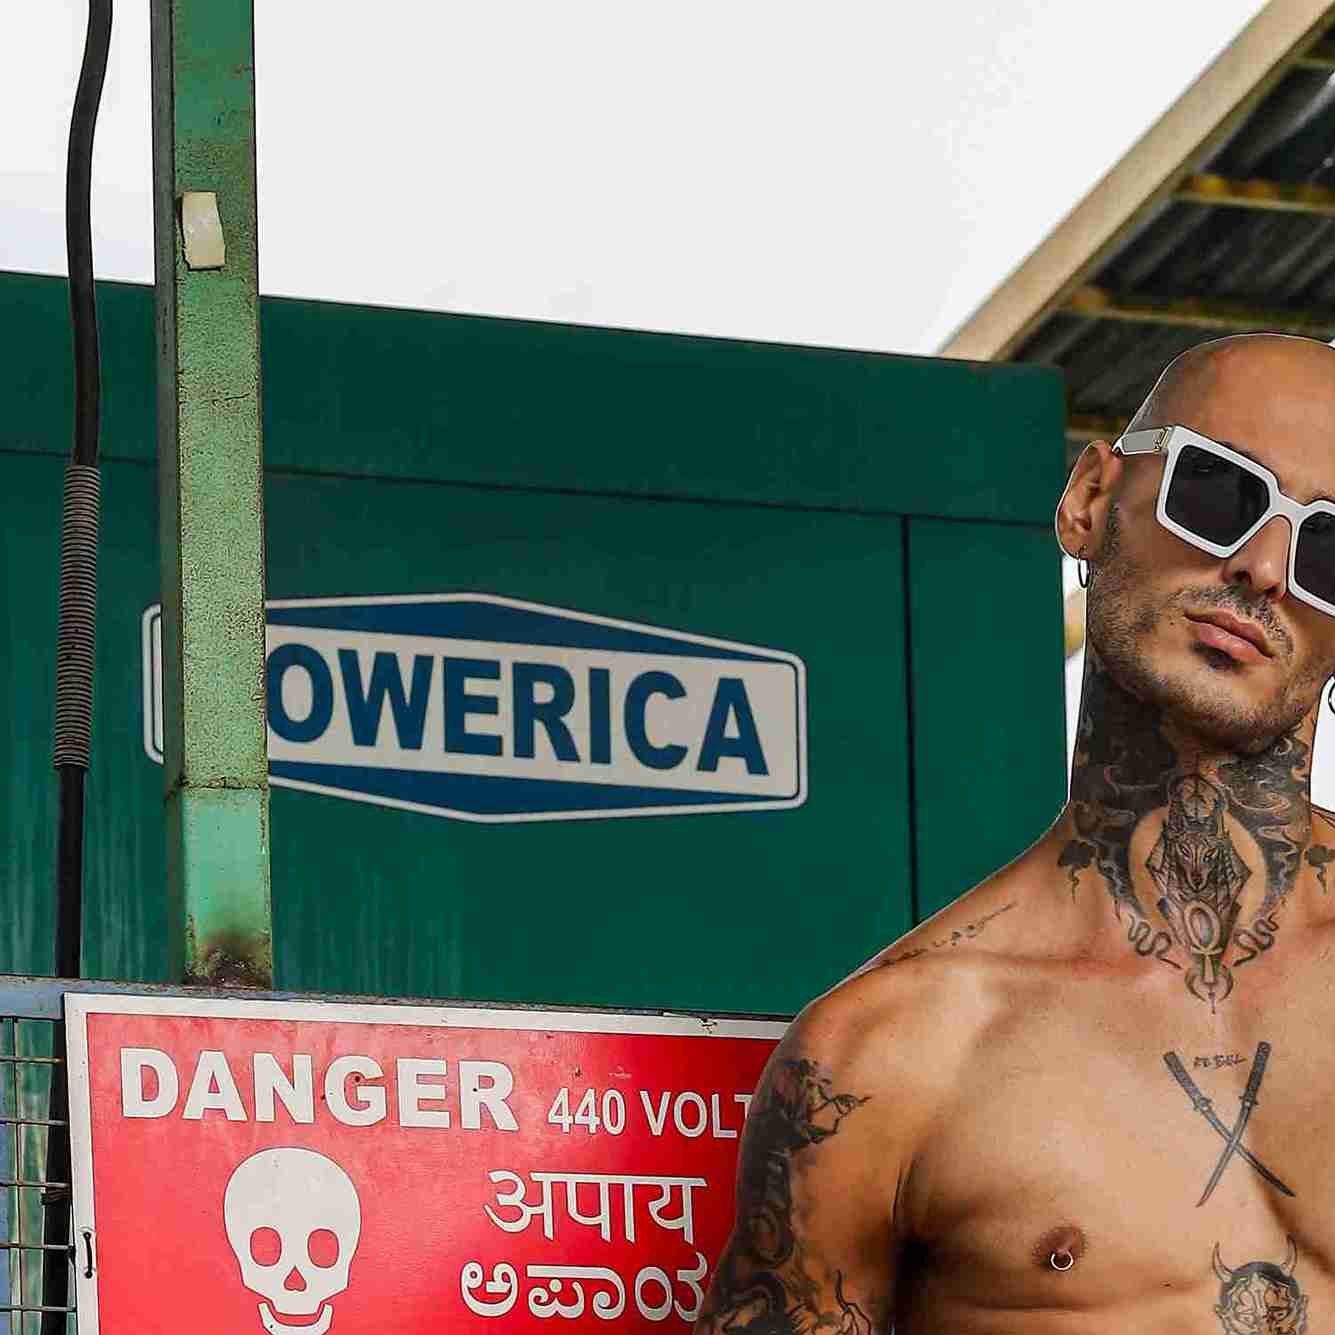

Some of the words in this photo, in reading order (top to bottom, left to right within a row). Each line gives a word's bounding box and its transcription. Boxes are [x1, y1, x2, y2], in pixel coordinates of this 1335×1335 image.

[265, 643, 770, 776] OWERICA
[120, 1047, 520, 1131] DANGER
[547, 1088, 626, 1136] 440
[483, 1169, 707, 1245] अपाय
